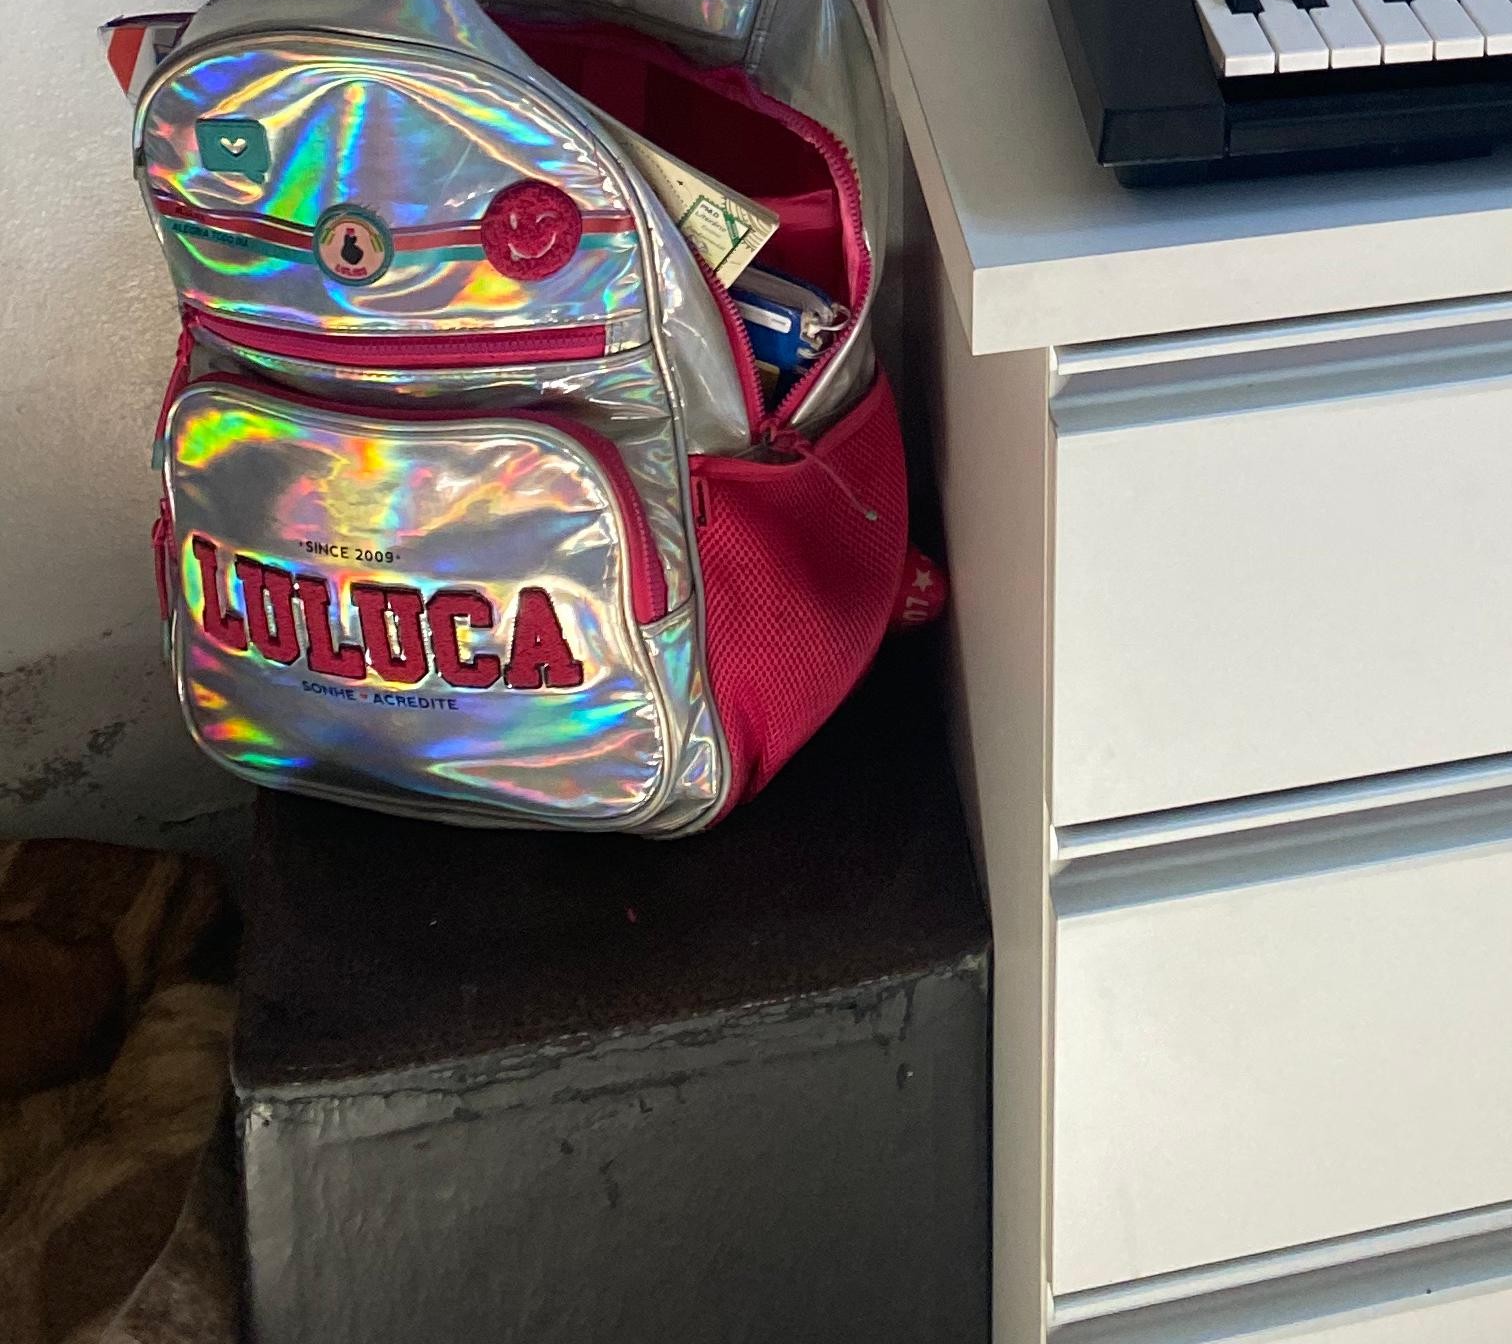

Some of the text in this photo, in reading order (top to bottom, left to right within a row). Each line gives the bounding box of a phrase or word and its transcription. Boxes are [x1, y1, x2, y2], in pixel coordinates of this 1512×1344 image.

[305, 540, 394, 563] SINCE 2009
[191, 533, 584, 690] LULUCA
[301, 680, 459, 710] SONHE ACREDITE
